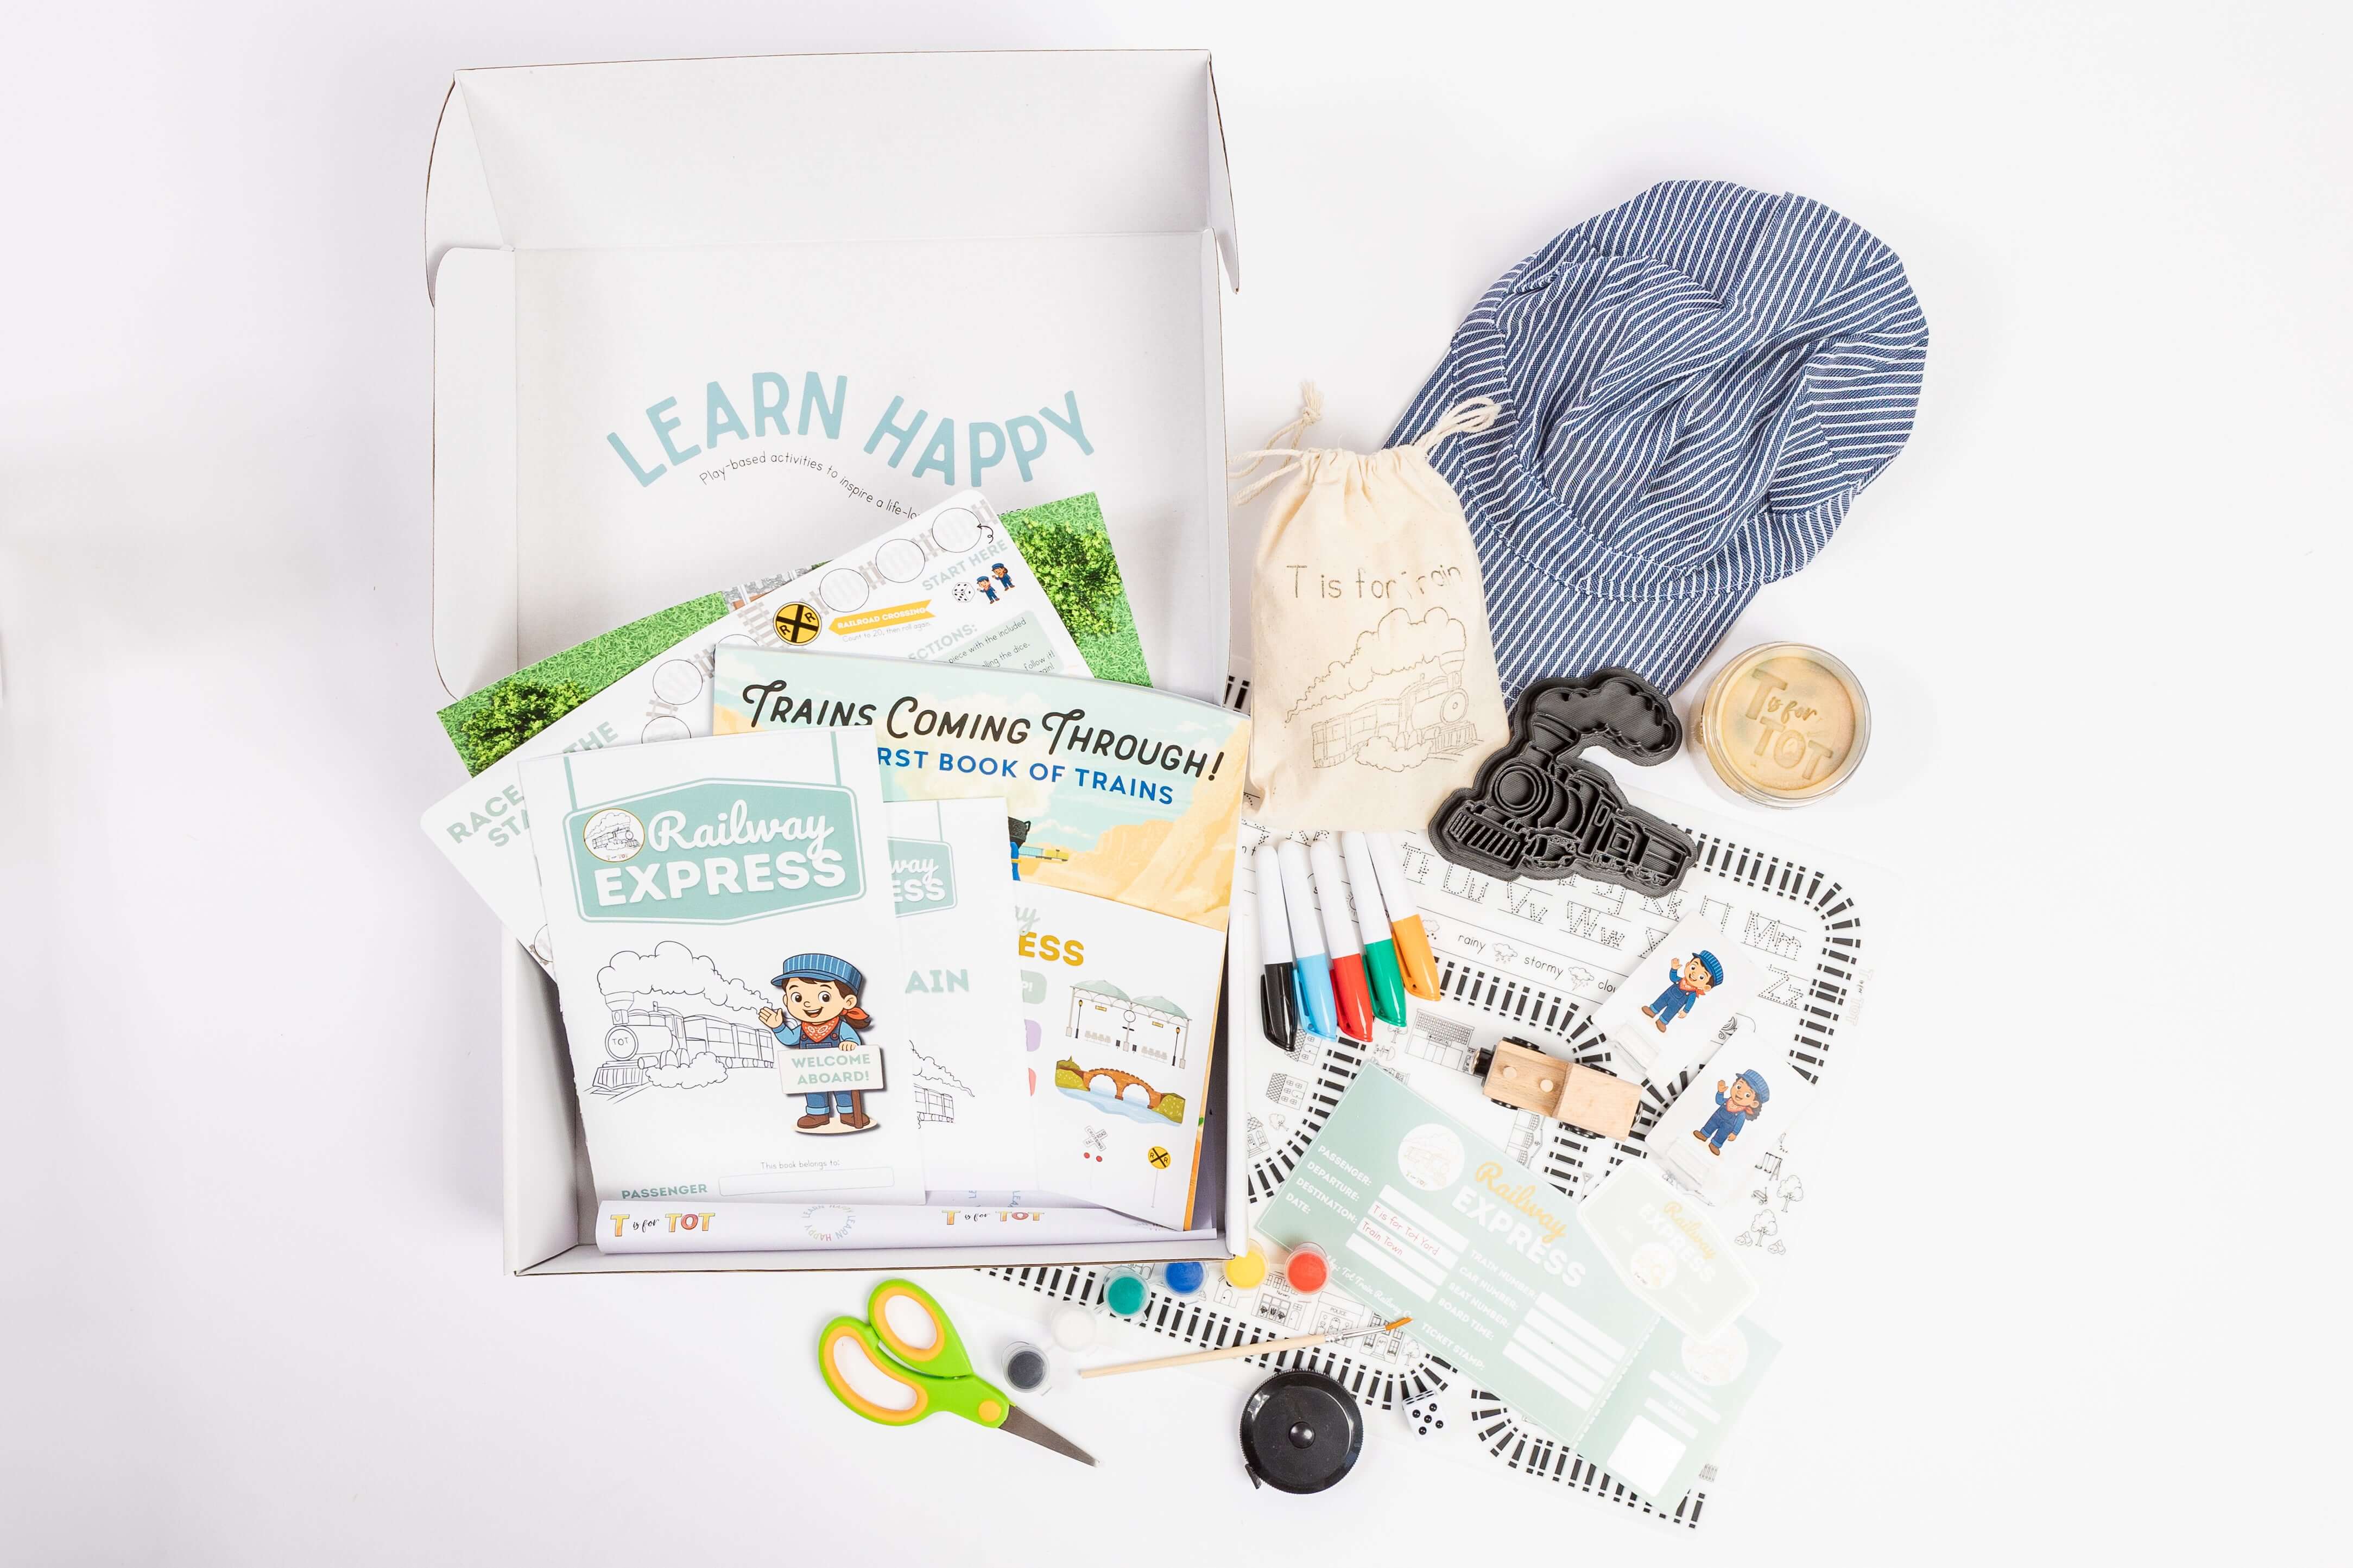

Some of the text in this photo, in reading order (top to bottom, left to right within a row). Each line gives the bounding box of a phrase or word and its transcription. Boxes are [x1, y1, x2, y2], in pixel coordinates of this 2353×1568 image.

[606, 371, 1095, 487] LEARN HAPPY
[699, 452, 920, 520] Play-based activities to inspire a life-lo
[922, 539, 1008, 591] START HERE
[1286, 564, 1462, 599] T is for rain
[779, 625, 790, 636] R
[804, 612, 816, 623] R
[837, 607, 926, 630] RAILROAD CROSSING
[842, 632, 862, 643] Count
[887, 626, 901, 634] then
[902, 624, 913, 632] roll
[914, 621, 931, 631] again.
[969, 641, 984, 653] with
[985, 633, 997, 645] the
[998, 617, 1026, 637] included
[1000, 651, 1012, 661] the
[1013, 643, 1030, 653] dice.
[1023, 658, 1045, 671] follow
[1745, 668, 1788, 720] T
[1781, 700, 1817, 724] for
[1760, 716, 1834, 780] TOT
[877, 747, 1174, 805] RST BOOK OF TRAINS
[446, 784, 525, 845] RACE
[647, 799, 834, 860] Railway
[594, 850, 846, 907] EXPRESS
[1457, 934, 1486, 954] rainy
[1524, 956, 1564, 980] stormy
[612, 1037, 629, 1046] TOT
[792, 1054, 870, 1068] WELCOME
[797, 1070, 869, 1085] ABOARD!
[761, 1161, 779, 1170] This
[781, 1160, 797, 1169] book
[799, 1159, 826, 1171] belongs
[1318, 1145, 1372, 1186] PASSENGER:
[622, 1184, 708, 1199] PASSENGER
[1307, 1160, 1359, 1202] DEPARTURE:
[1286, 1192, 1312, 1215] DATE:
[1296, 1177, 1358, 1224] DESTINATION:
[1475, 1160, 1568, 1245] Railway
[610, 1214, 630, 1237] T
[641, 1218, 660, 1233] for
[665, 1212, 716, 1233] TOT
[942, 1210, 960, 1225] T
[995, 1210, 1044, 1222] TOT
[1372, 1204, 1381, 1215] T
[1381, 1210, 1388, 1221] is
[1390, 1216, 1403, 1230] for
[1405, 1226, 1421, 1242] Tot
[1362, 1221, 1403, 1256] Train Town
[1451, 1185, 1586, 1288] EXPRESS
[1471, 1249, 1498, 1273] TRAIN
[1459, 1266, 1479, 1285] CAR
[1449, 1282, 1471, 1301] SEAT
[1330, 1306, 1347, 1317] POLICE
[1438, 1298, 1470, 1323] BOARD
[1422, 1321, 1454, 1349] TICKET
